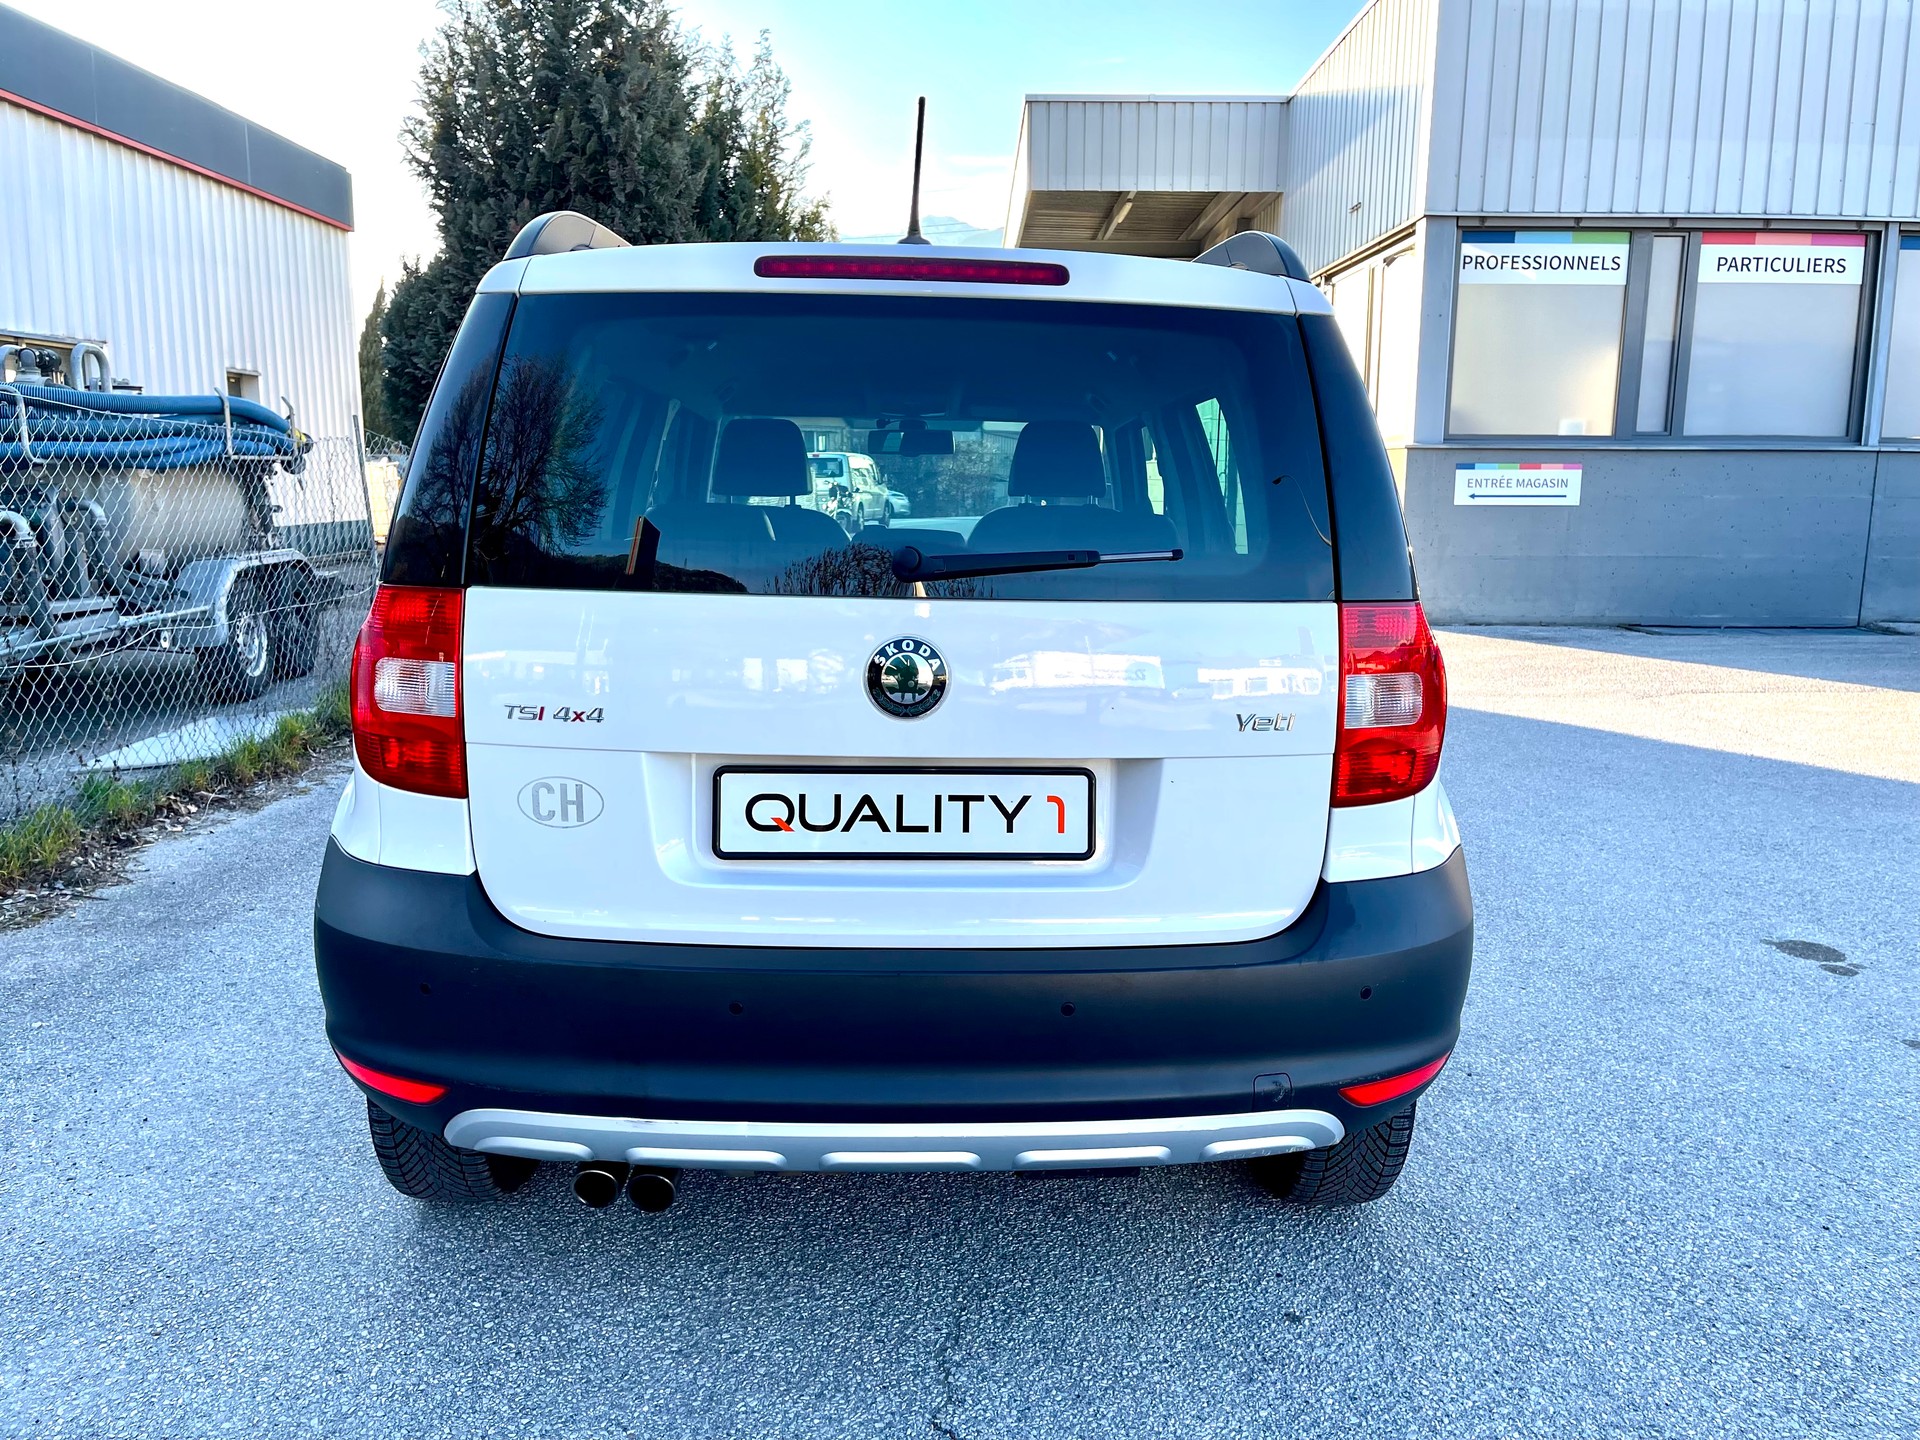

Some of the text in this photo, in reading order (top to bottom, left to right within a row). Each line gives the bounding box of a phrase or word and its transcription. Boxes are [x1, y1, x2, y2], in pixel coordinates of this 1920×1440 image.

[1462, 255, 1622, 271] PROFESSIONNELS
[1717, 256, 1847, 274] PARTICULIERS
[1467, 475, 1569, 489] ENTRÉE MAGASIN
[504, 704, 605, 723] TSI 4x4
[1236, 713, 1297, 732] Yeti
[532, 781, 585, 823] CH
[745, 793, 1066, 834] QUALITY 1
